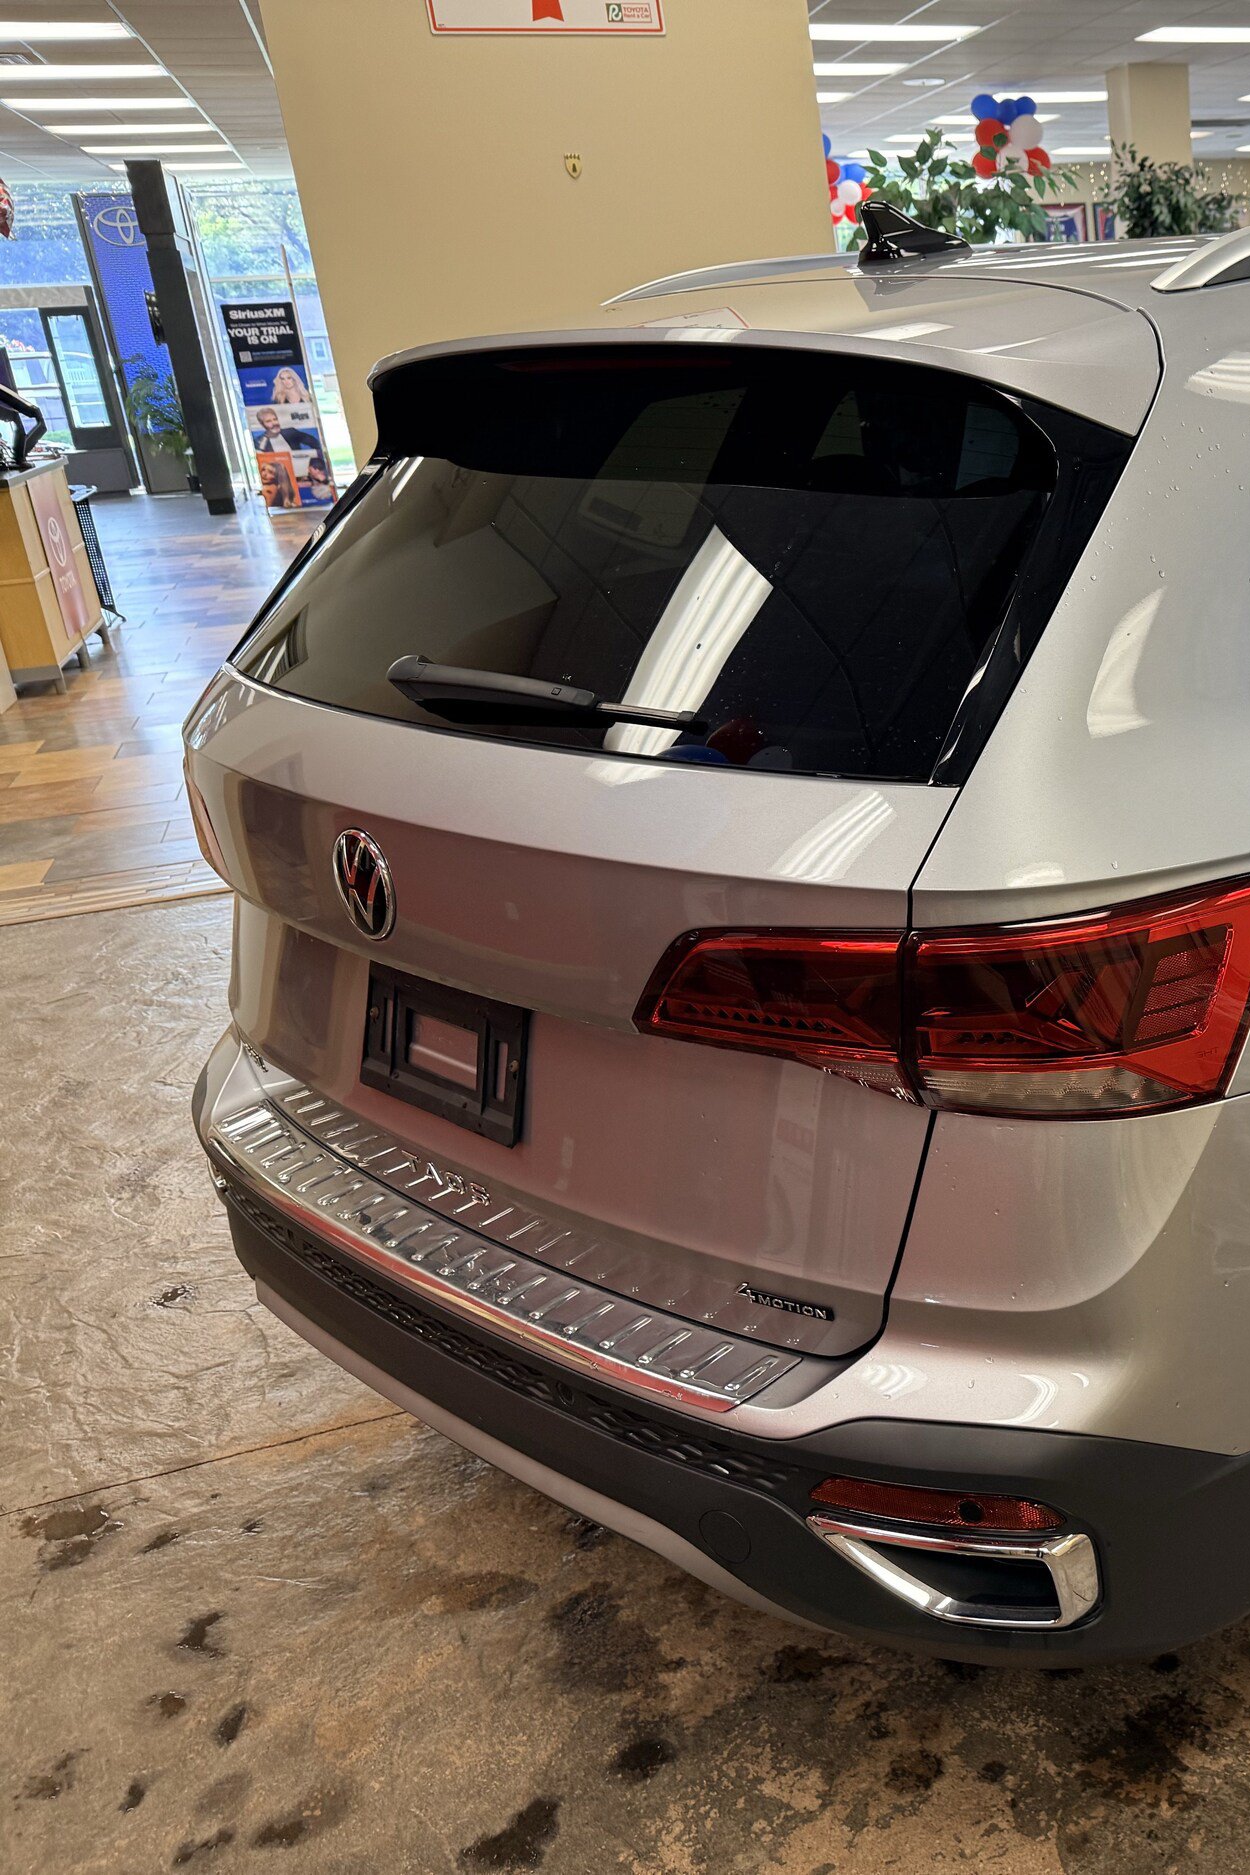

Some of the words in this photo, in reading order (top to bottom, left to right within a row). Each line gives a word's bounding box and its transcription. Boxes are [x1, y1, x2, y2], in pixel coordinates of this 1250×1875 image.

[229, 308, 286, 320] SiriusXM
[228, 327, 260, 338] YOUR
[260, 325, 294, 336] TRIAL
[247, 336, 259, 345] IS
[260, 335, 279, 344] ON
